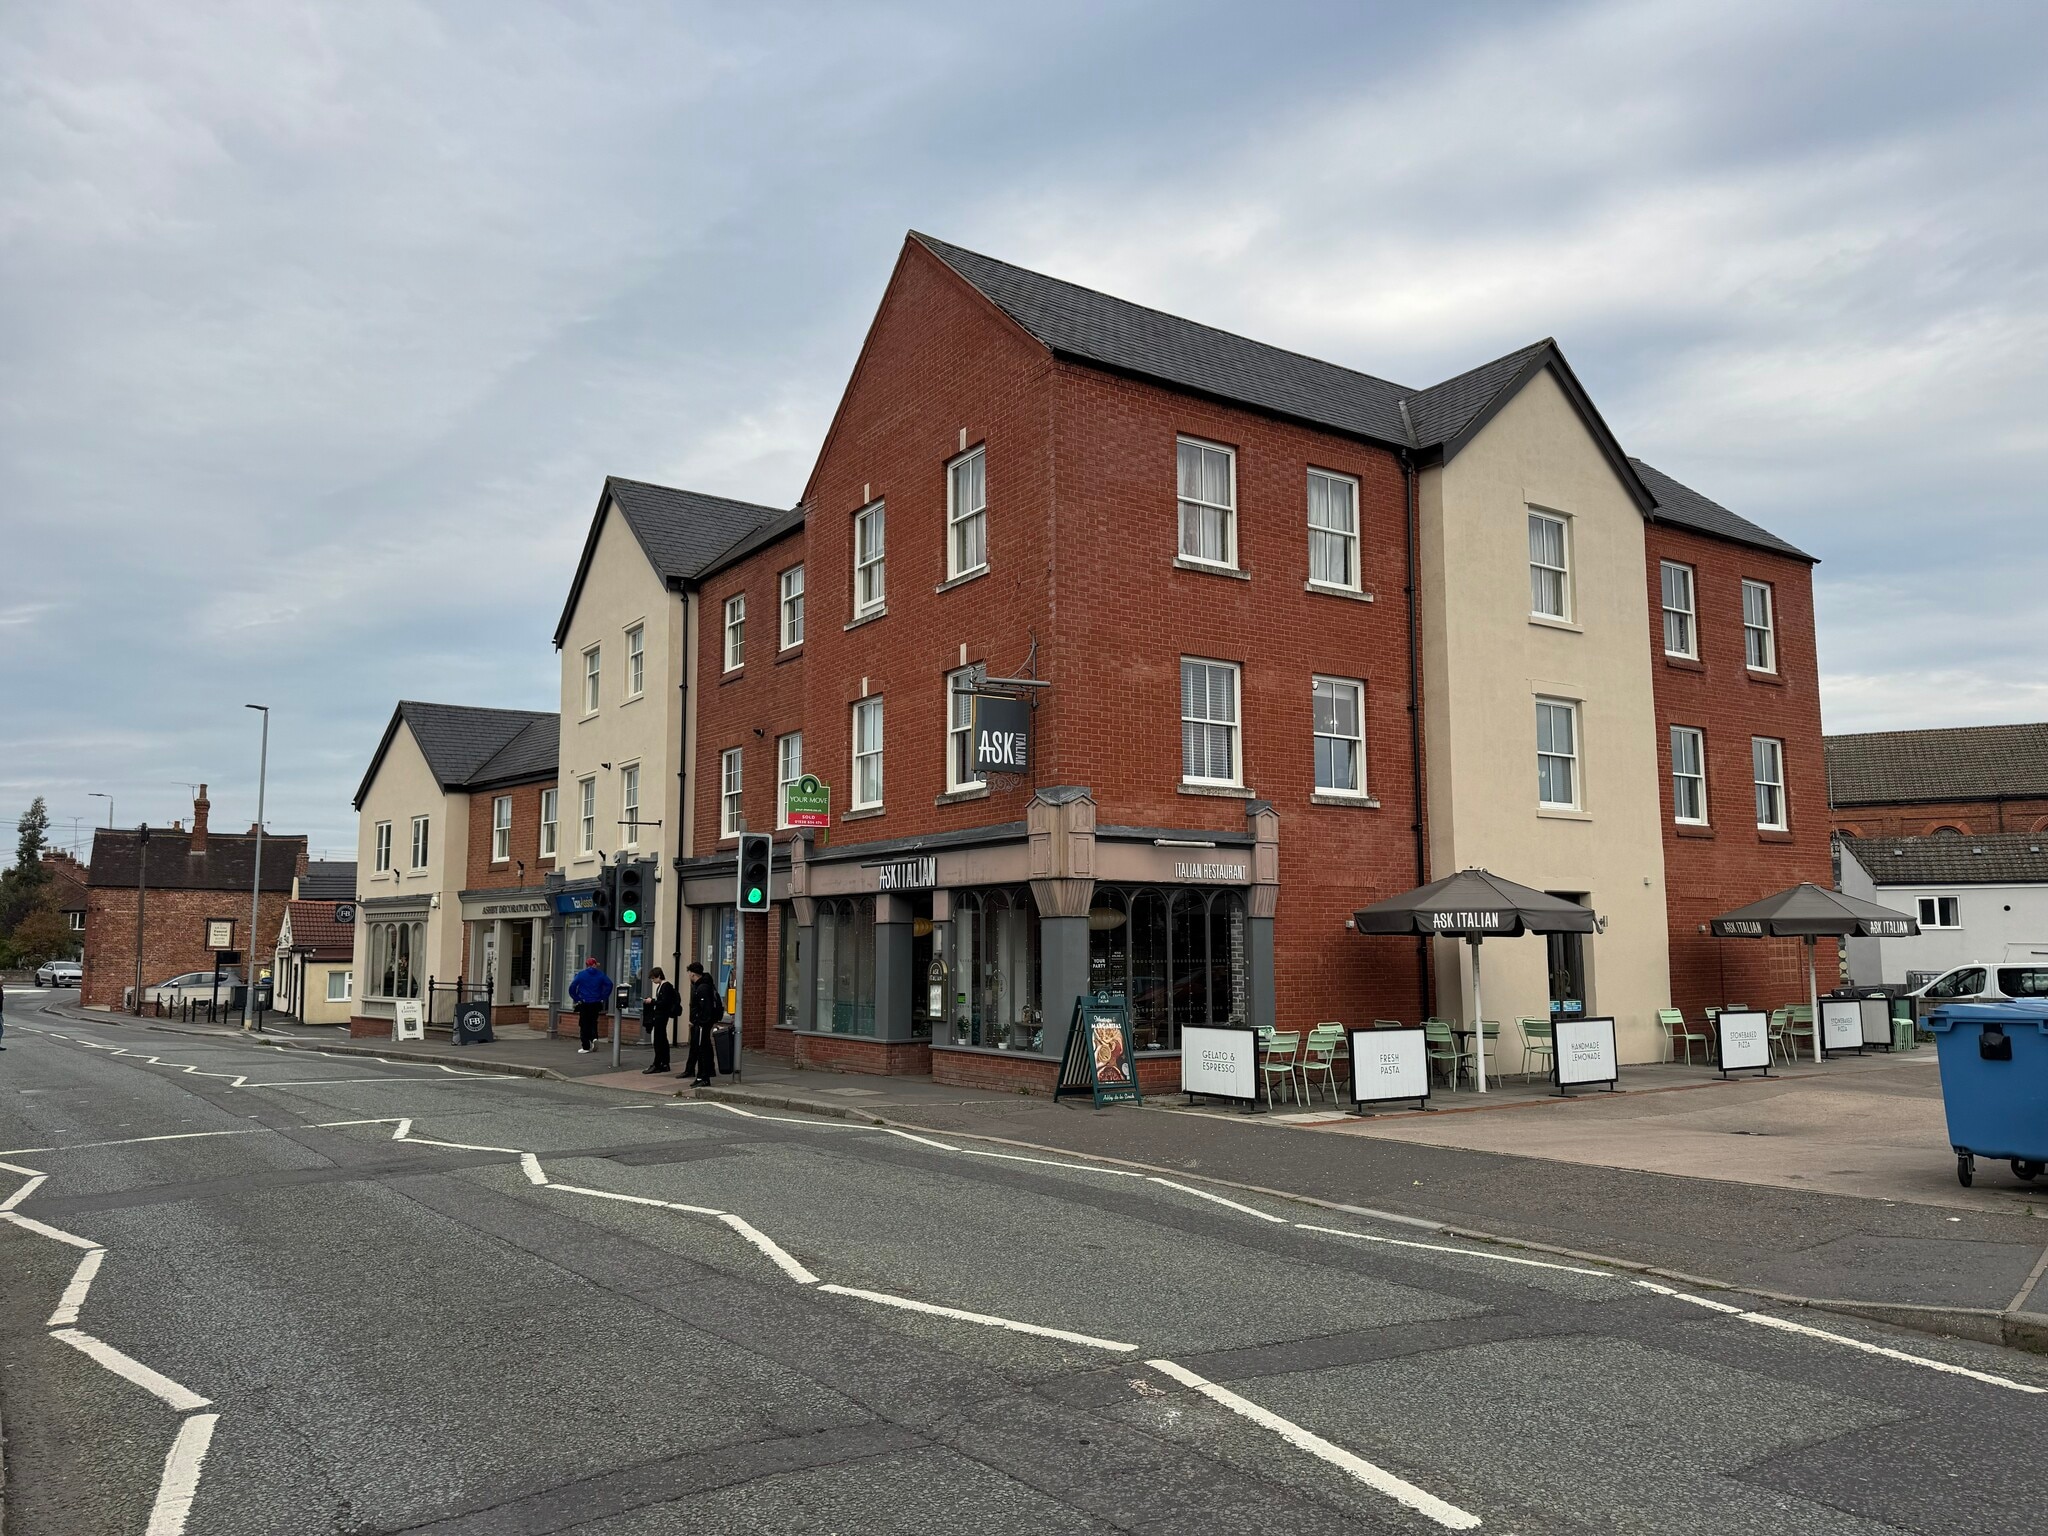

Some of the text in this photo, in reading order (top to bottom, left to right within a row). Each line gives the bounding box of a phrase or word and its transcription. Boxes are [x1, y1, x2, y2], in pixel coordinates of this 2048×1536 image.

[978, 730, 1014, 764] ASK
[1015, 733, 1026, 765] ITALIAN
[879, 865, 897, 889] ASK
[1175, 862, 1246, 880] ITALIAN RESTAURANT
[499, 904, 530, 913] DECORATOR
[1433, 912, 1499, 928] ASK ITALIAN
[1723, 921, 1763, 933] ASK ITALIAN
[1870, 921, 1908, 934] ASK ITALIAN
[1571, 1041, 1600, 1050] HANDMADE
[1202, 1050, 1235, 1061] GELATO &
[1380, 1053, 1400, 1062] FRESH
[1571, 1052, 1601, 1061] LEMONADE
[1202, 1061, 1236, 1073] ESPRESSO
[1380, 1065, 1400, 1075] PASTA
